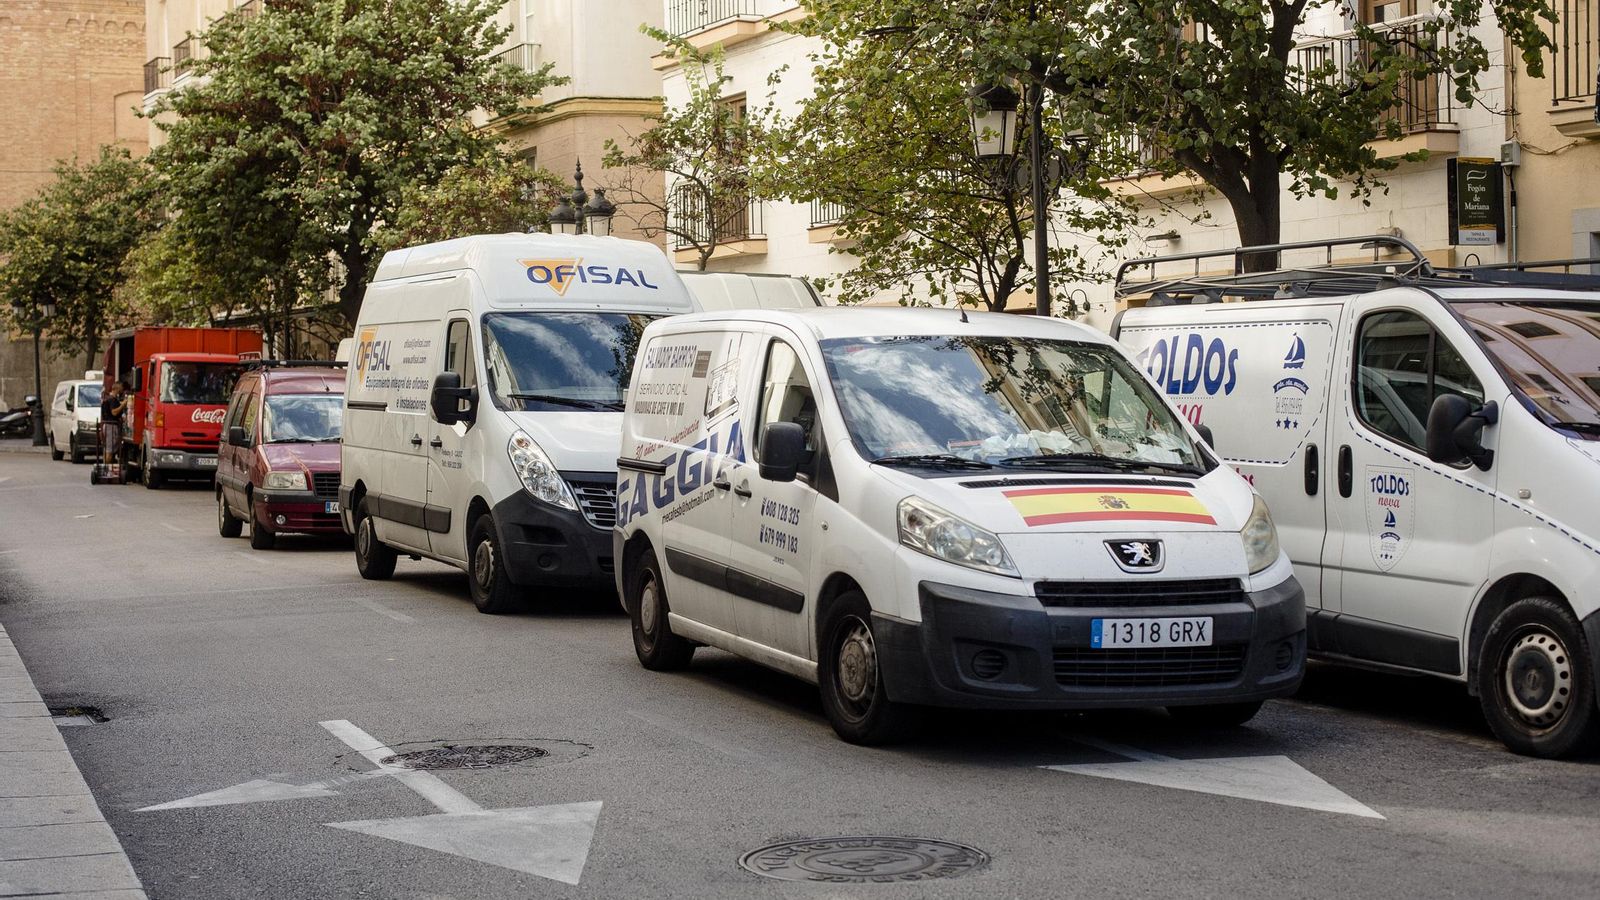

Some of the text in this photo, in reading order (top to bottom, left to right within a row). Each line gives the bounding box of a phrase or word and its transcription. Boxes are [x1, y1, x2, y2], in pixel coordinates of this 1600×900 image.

[1467, 183, 1486, 193] Fogón
[1472, 194, 1481, 202] de
[1464, 202, 1490, 210] Mariana
[526, 265, 658, 289] OFISAL
[356, 340, 391, 371] OFISAL
[645, 346, 673, 368] SALVADOR
[405, 376, 412, 389] de
[639, 383, 688, 396] SERVICIO OFICAL
[616, 418, 747, 529] GAGGIA
[1370, 475, 1410, 496] TOLDOS
[1377, 497, 1400, 508] nova
[788, 507, 800, 526] 325
[764, 527, 798, 554] 679 999 183
[1111, 622, 1161, 643] 1318
[1169, 620, 1207, 643] GRX
